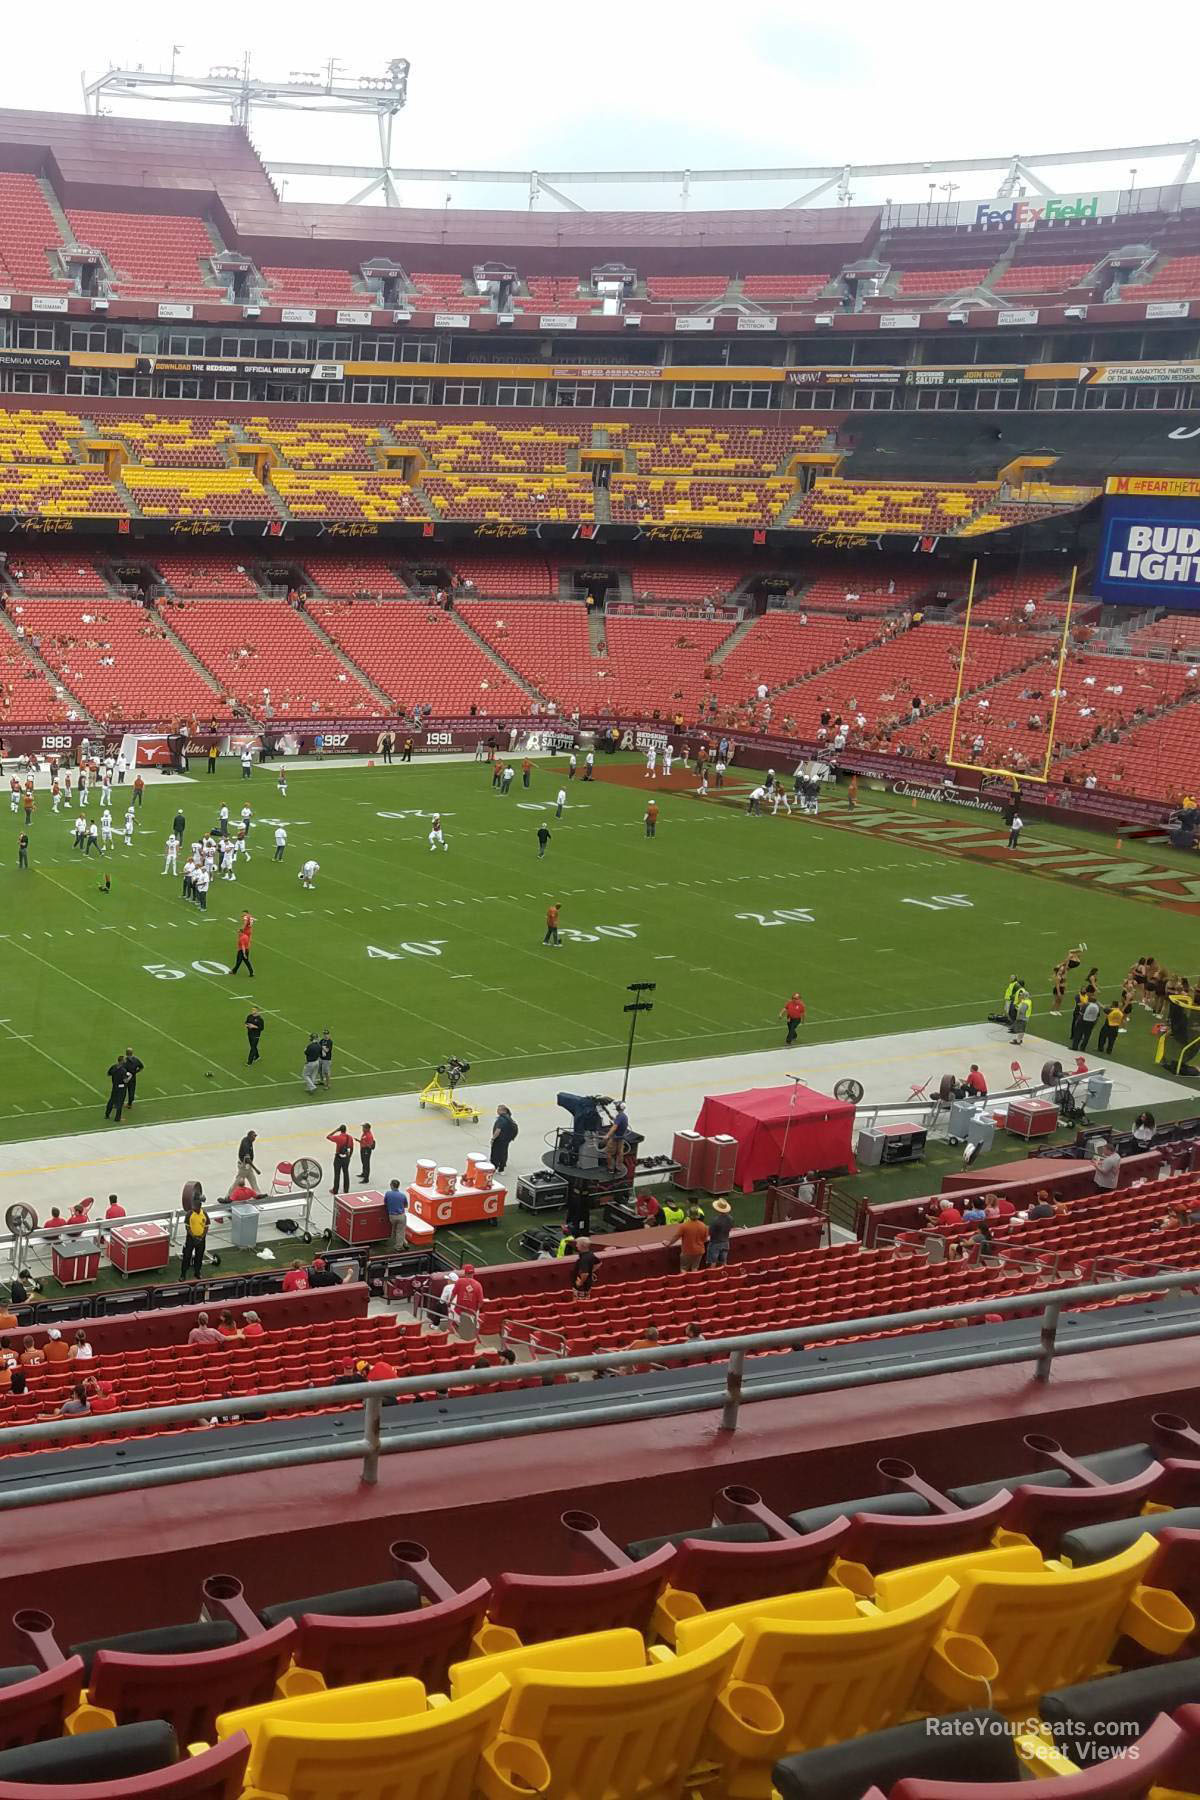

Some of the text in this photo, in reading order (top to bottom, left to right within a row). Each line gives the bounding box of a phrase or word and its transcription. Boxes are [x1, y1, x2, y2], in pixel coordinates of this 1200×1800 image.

[33, 358, 61, 366] VODKA
[1127, 525, 1200, 554] BUD
[41, 736, 73, 749] 1983
[426, 733, 453, 745] 1991
[635, 737, 668, 750] SALUTE
[892, 780, 1003, 813] Charitable Foundation
[366, 939, 442, 960] 40
[143, 958, 231, 980] 50
[437, 1201, 453, 1220] G
[483, 1194, 498, 1214] G
